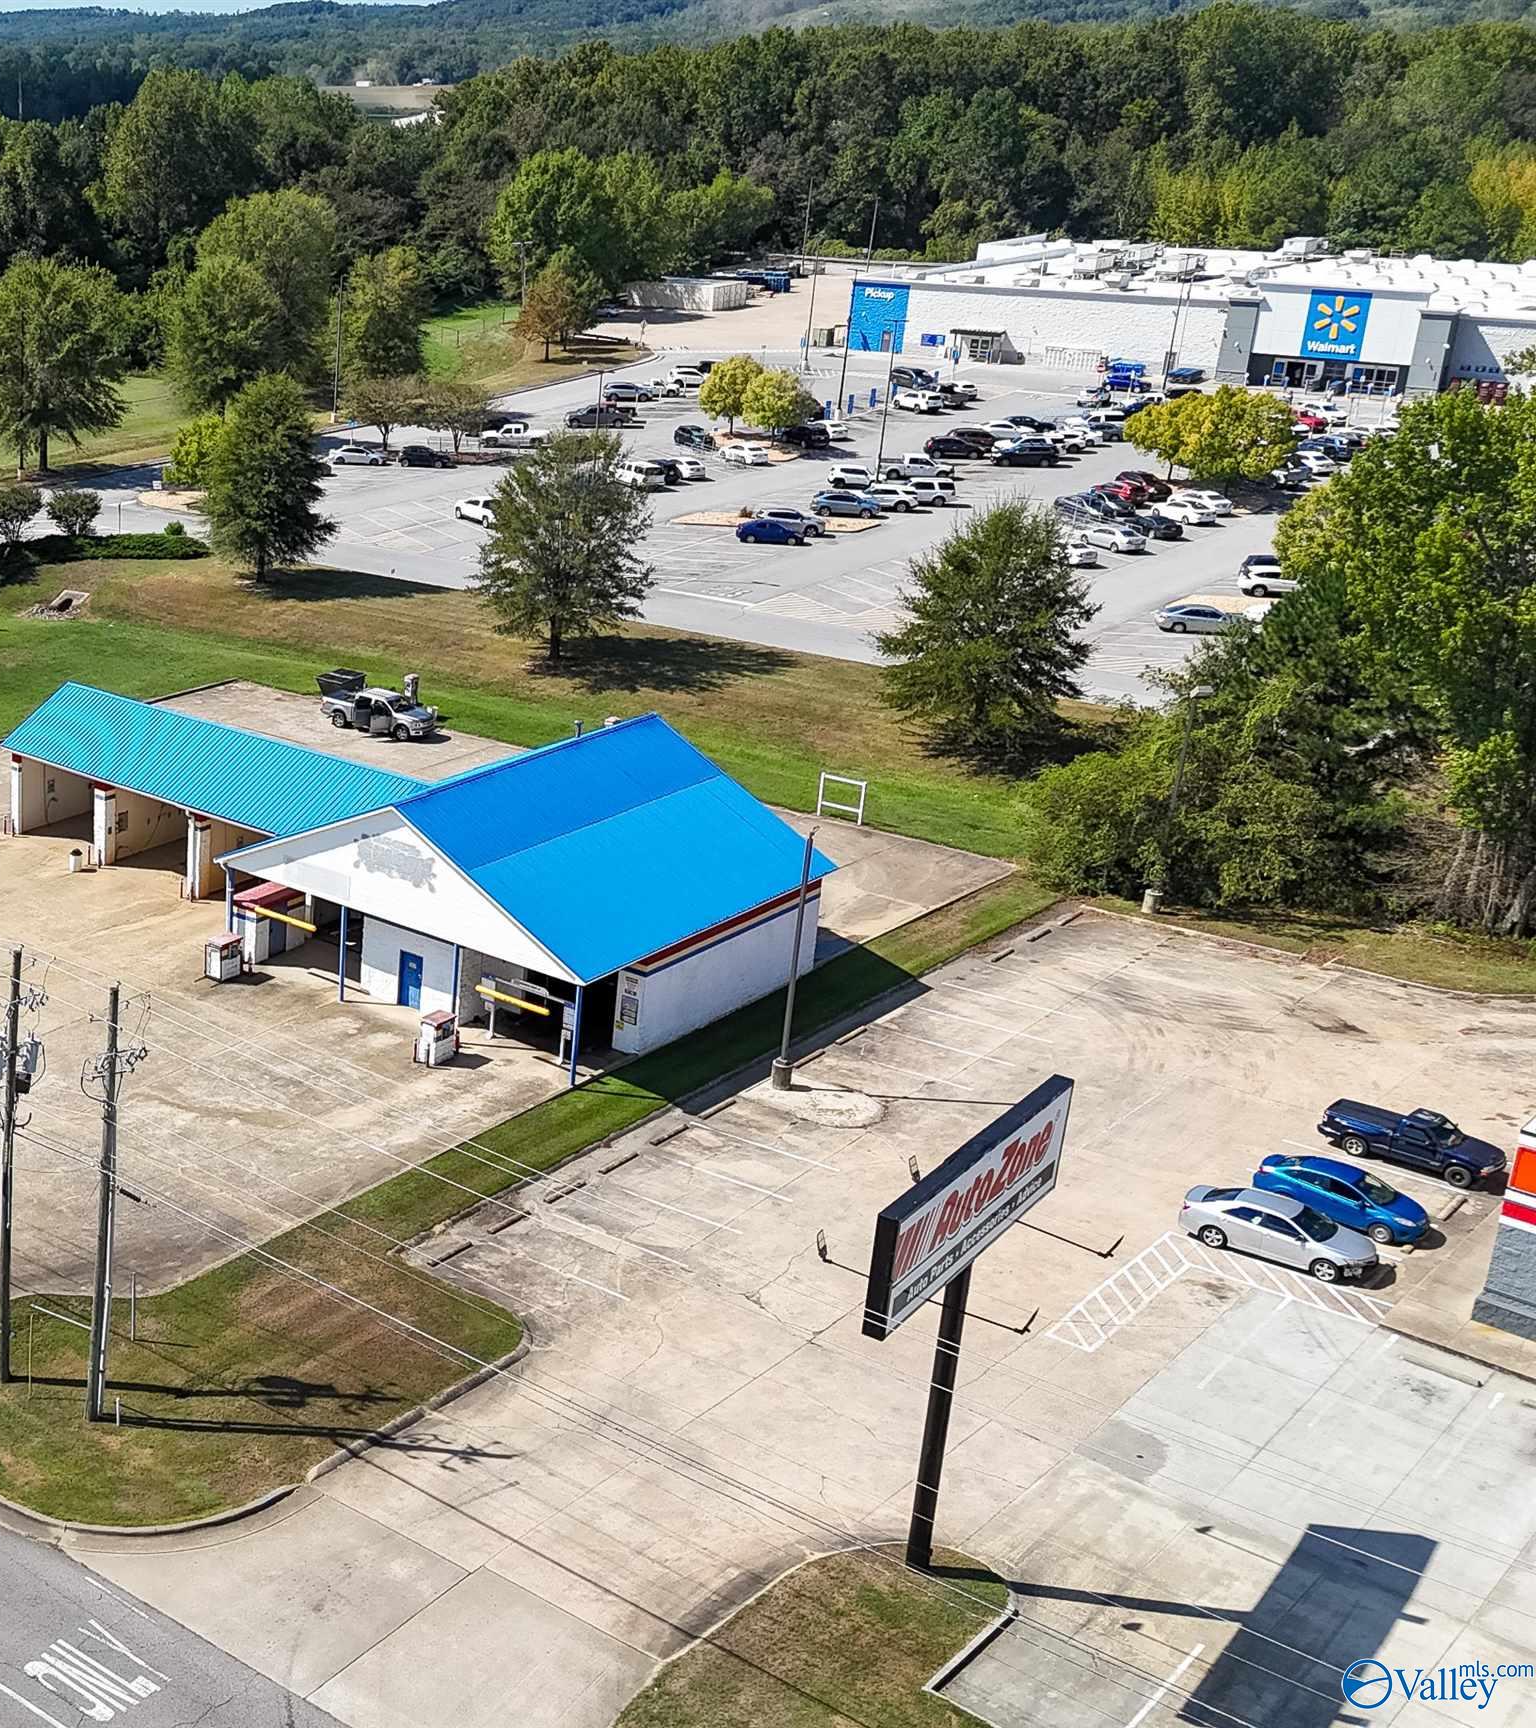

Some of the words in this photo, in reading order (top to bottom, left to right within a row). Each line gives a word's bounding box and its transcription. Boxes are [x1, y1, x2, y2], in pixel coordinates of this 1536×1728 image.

[864, 287, 895, 301] Pickup
[1307, 340, 1357, 355] Walmart
[929, 1119, 1056, 1253] AutoZone
[906, 1275, 928, 1302] Auto
[930, 1254, 954, 1283] Parts
[960, 1205, 1011, 1255] Accessories
[1016, 1175, 1043, 1206] Advice
[23, 1618, 172, 1722] ONLY
